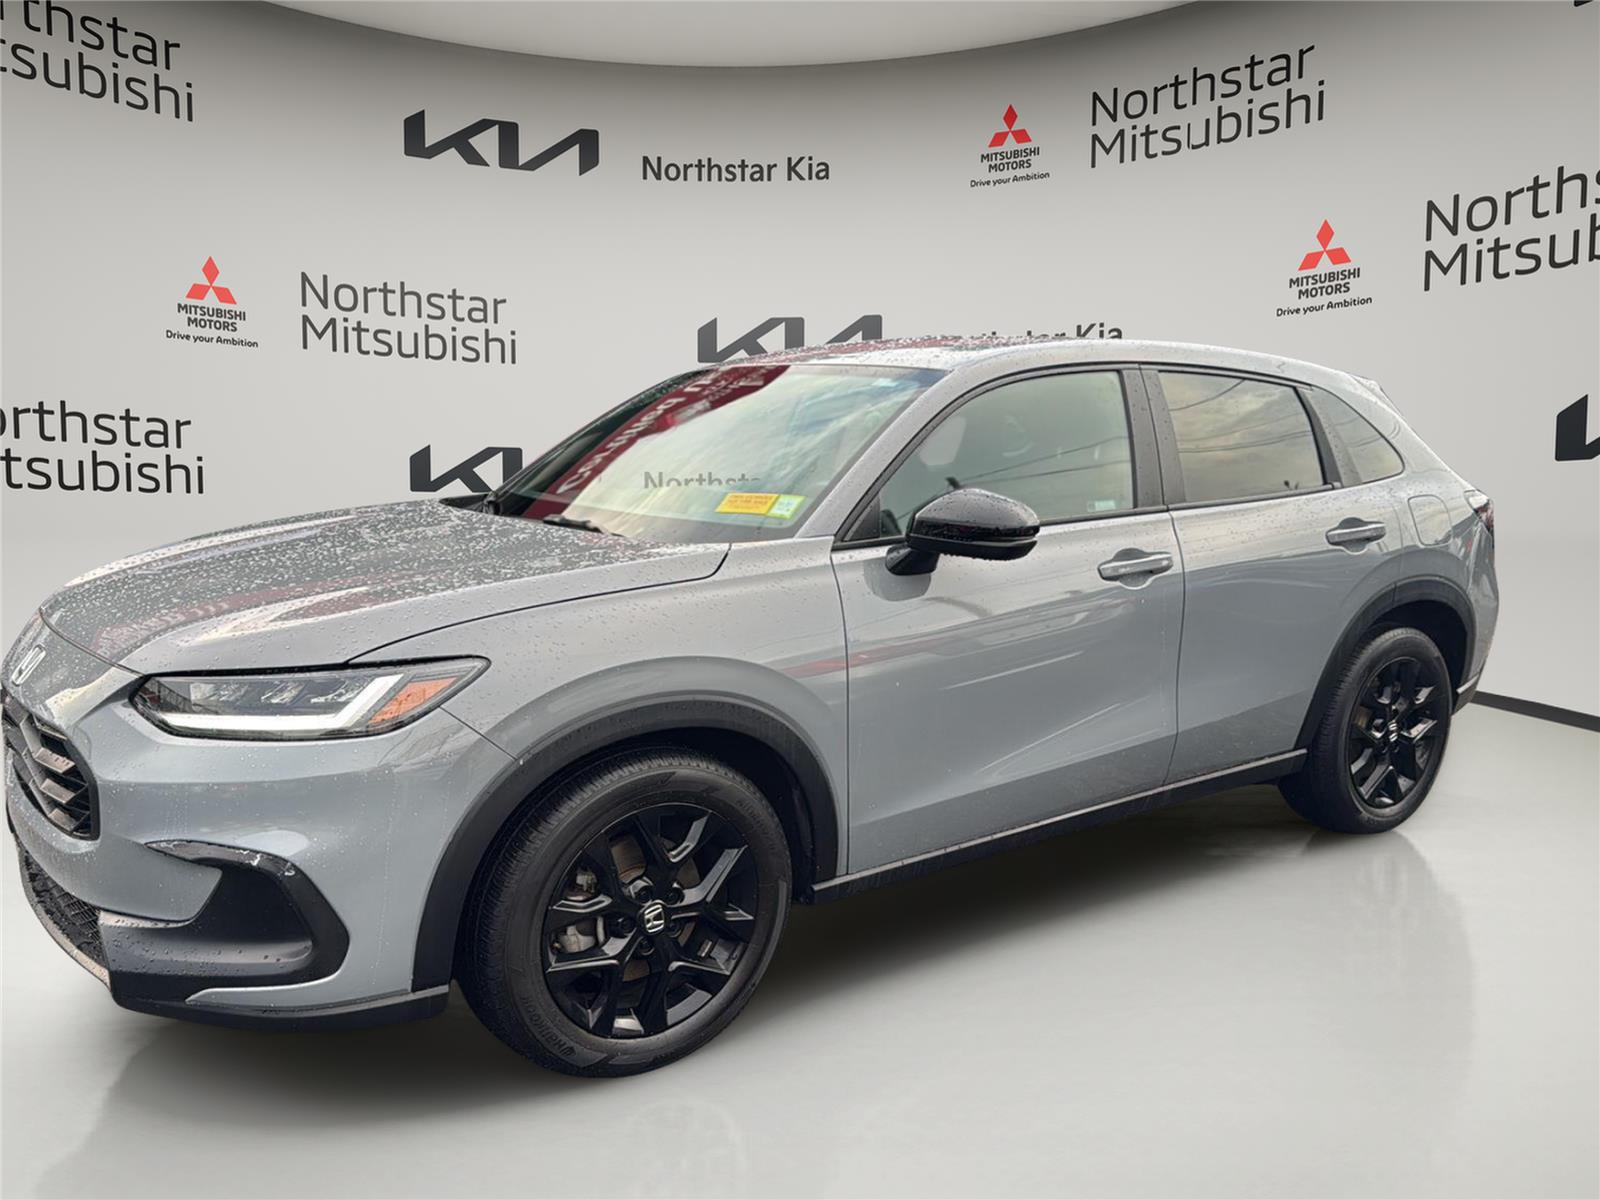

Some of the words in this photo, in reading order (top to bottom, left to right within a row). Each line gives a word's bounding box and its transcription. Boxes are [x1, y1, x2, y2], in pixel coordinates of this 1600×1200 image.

[0, 0, 180, 70] thstar
[1092, 45, 1315, 127] Northstar
[1090, 80, 1325, 169] Mitsubishi
[404, 109, 599, 176] KIA
[980, 146, 1040, 163] MITSUBISHI
[642, 156, 777, 182] Northstar
[786, 156, 830, 181] Kia
[988, 159, 1032, 173] MOTORS
[970, 179, 991, 188] Drive
[992, 177, 1011, 186] your
[1012, 172, 1050, 183] Ambition
[1426, 166, 1600, 242] North
[1289, 267, 1361, 289] MITSUBISHI
[1298, 282, 1351, 300] MOTORS
[301, 271, 507, 325] Northstar
[1276, 306, 1301, 317] Drive
[1303, 304, 1325, 315] your
[1326, 296, 1373, 310] Ambition
[177, 303, 246, 321] MITSUBISHI
[187, 316, 238, 332] MOTORS
[165, 329, 191, 341] Drive
[192, 333, 214, 344] your
[216, 336, 259, 348] Ambition
[301, 314, 517, 365] Mitsubishi
[0, 400, 191, 449] rthstar
[410, 444, 523, 492] KI
